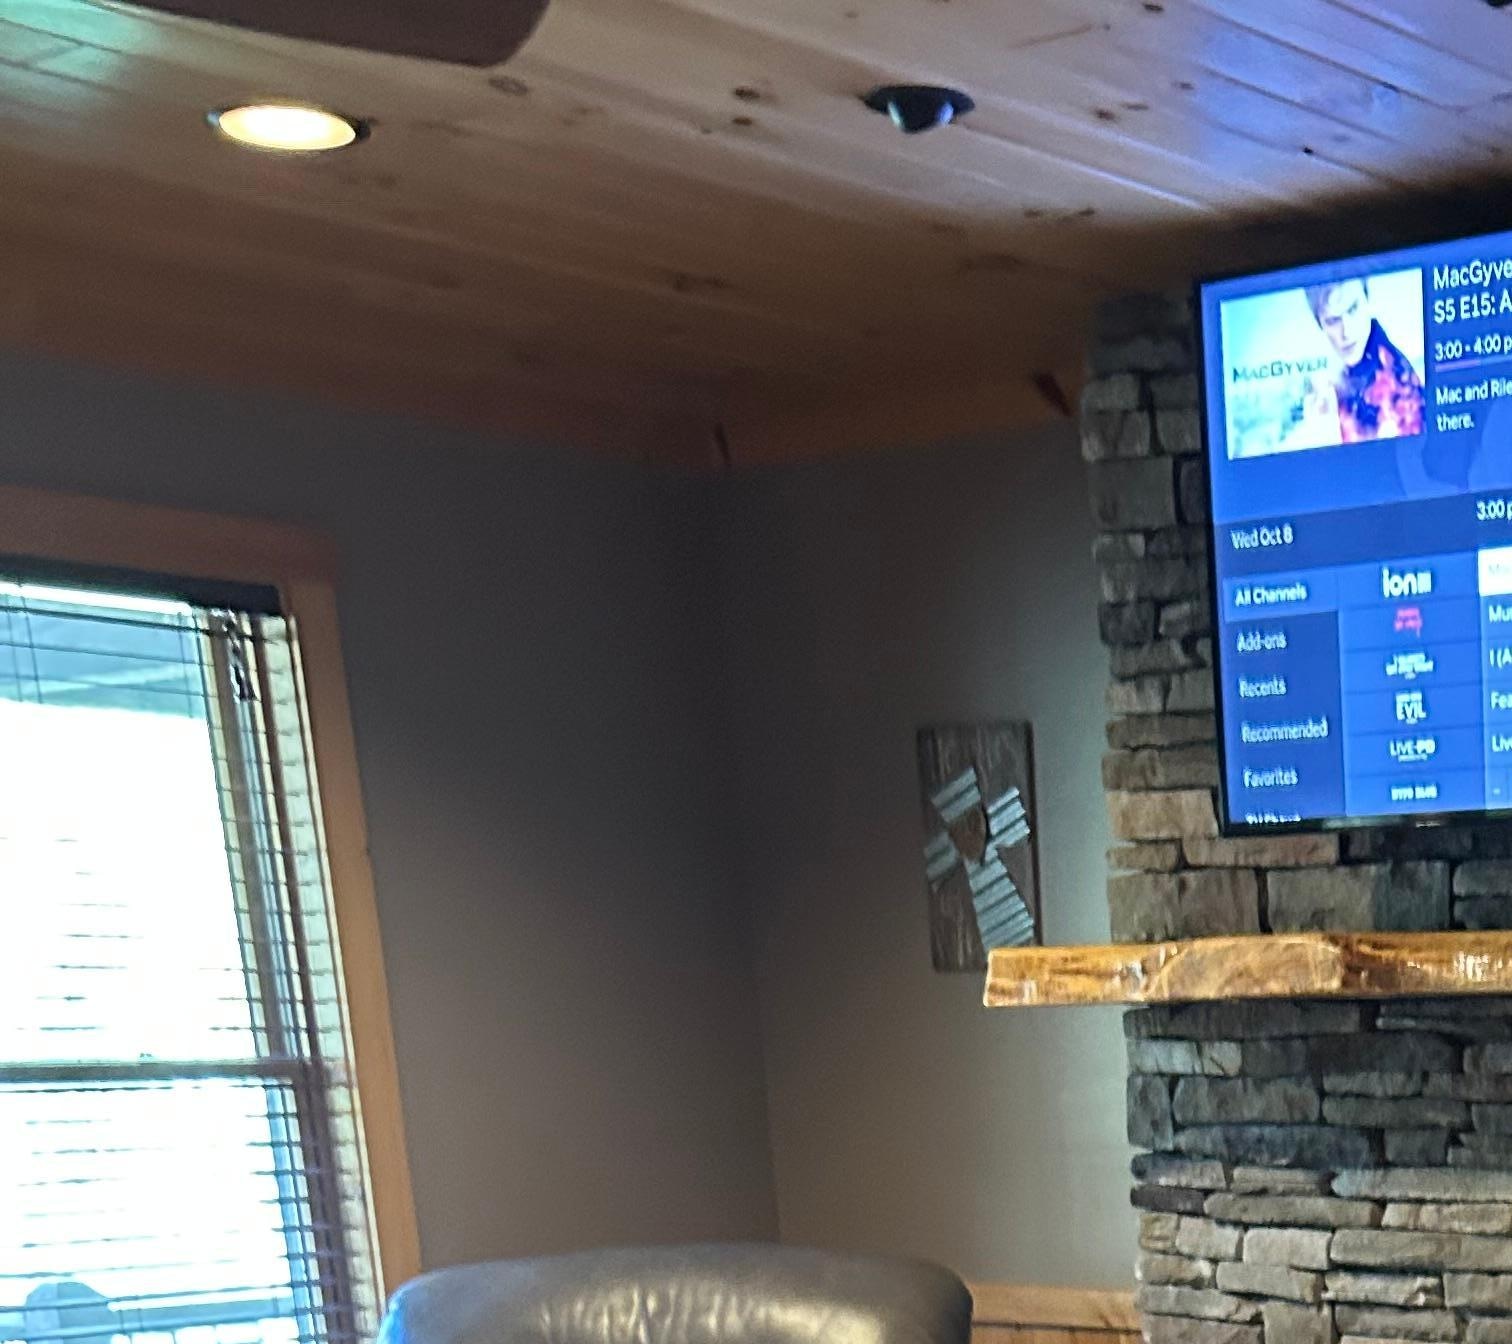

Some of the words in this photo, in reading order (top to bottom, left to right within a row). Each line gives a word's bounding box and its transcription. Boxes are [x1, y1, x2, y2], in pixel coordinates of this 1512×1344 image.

[1434, 299, 1456, 323] S5
[1460, 293, 1496, 320] E15:
[1435, 340, 1462, 361] 3:00
[1474, 334, 1501, 355] 4:00
[1436, 387, 1462, 405] Mac
[1465, 381, 1488, 401] and
[1437, 413, 1474, 432] there.
[1477, 500, 1505, 520] 3:00
[1231, 529, 1258, 549] Wed
[1260, 526, 1282, 545] Oct
[1235, 589, 1250, 606] All
[1253, 582, 1307, 604] Channels
[1237, 631, 1287, 652] Add-ons
[1239, 676, 1287, 698] Recents
[1241, 715, 1329, 744] Recommended
[1243, 767, 1298, 788] Favorites
